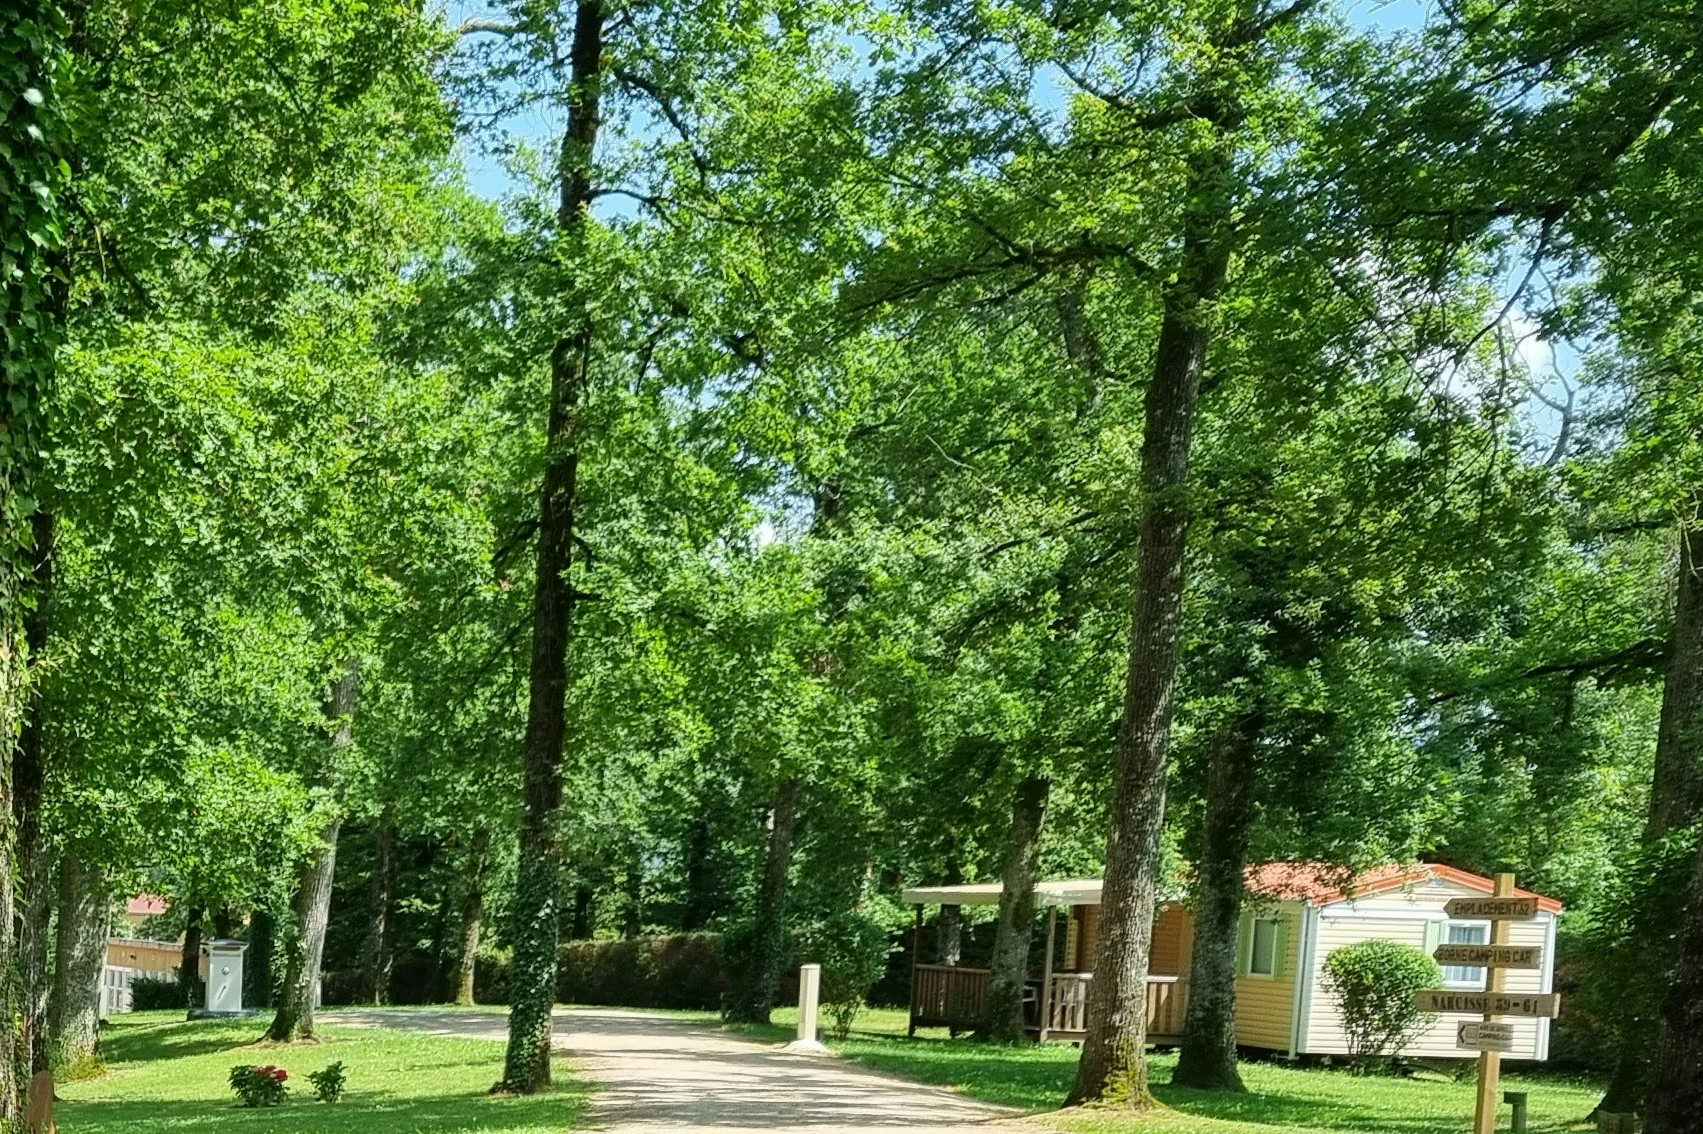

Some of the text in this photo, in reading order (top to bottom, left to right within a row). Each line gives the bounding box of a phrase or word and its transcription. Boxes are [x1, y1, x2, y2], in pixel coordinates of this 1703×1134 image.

[1468, 949, 1511, 963] CAMPING
[1512, 950, 1532, 964] CAR
[1431, 995, 1490, 1010] NARCISSE
